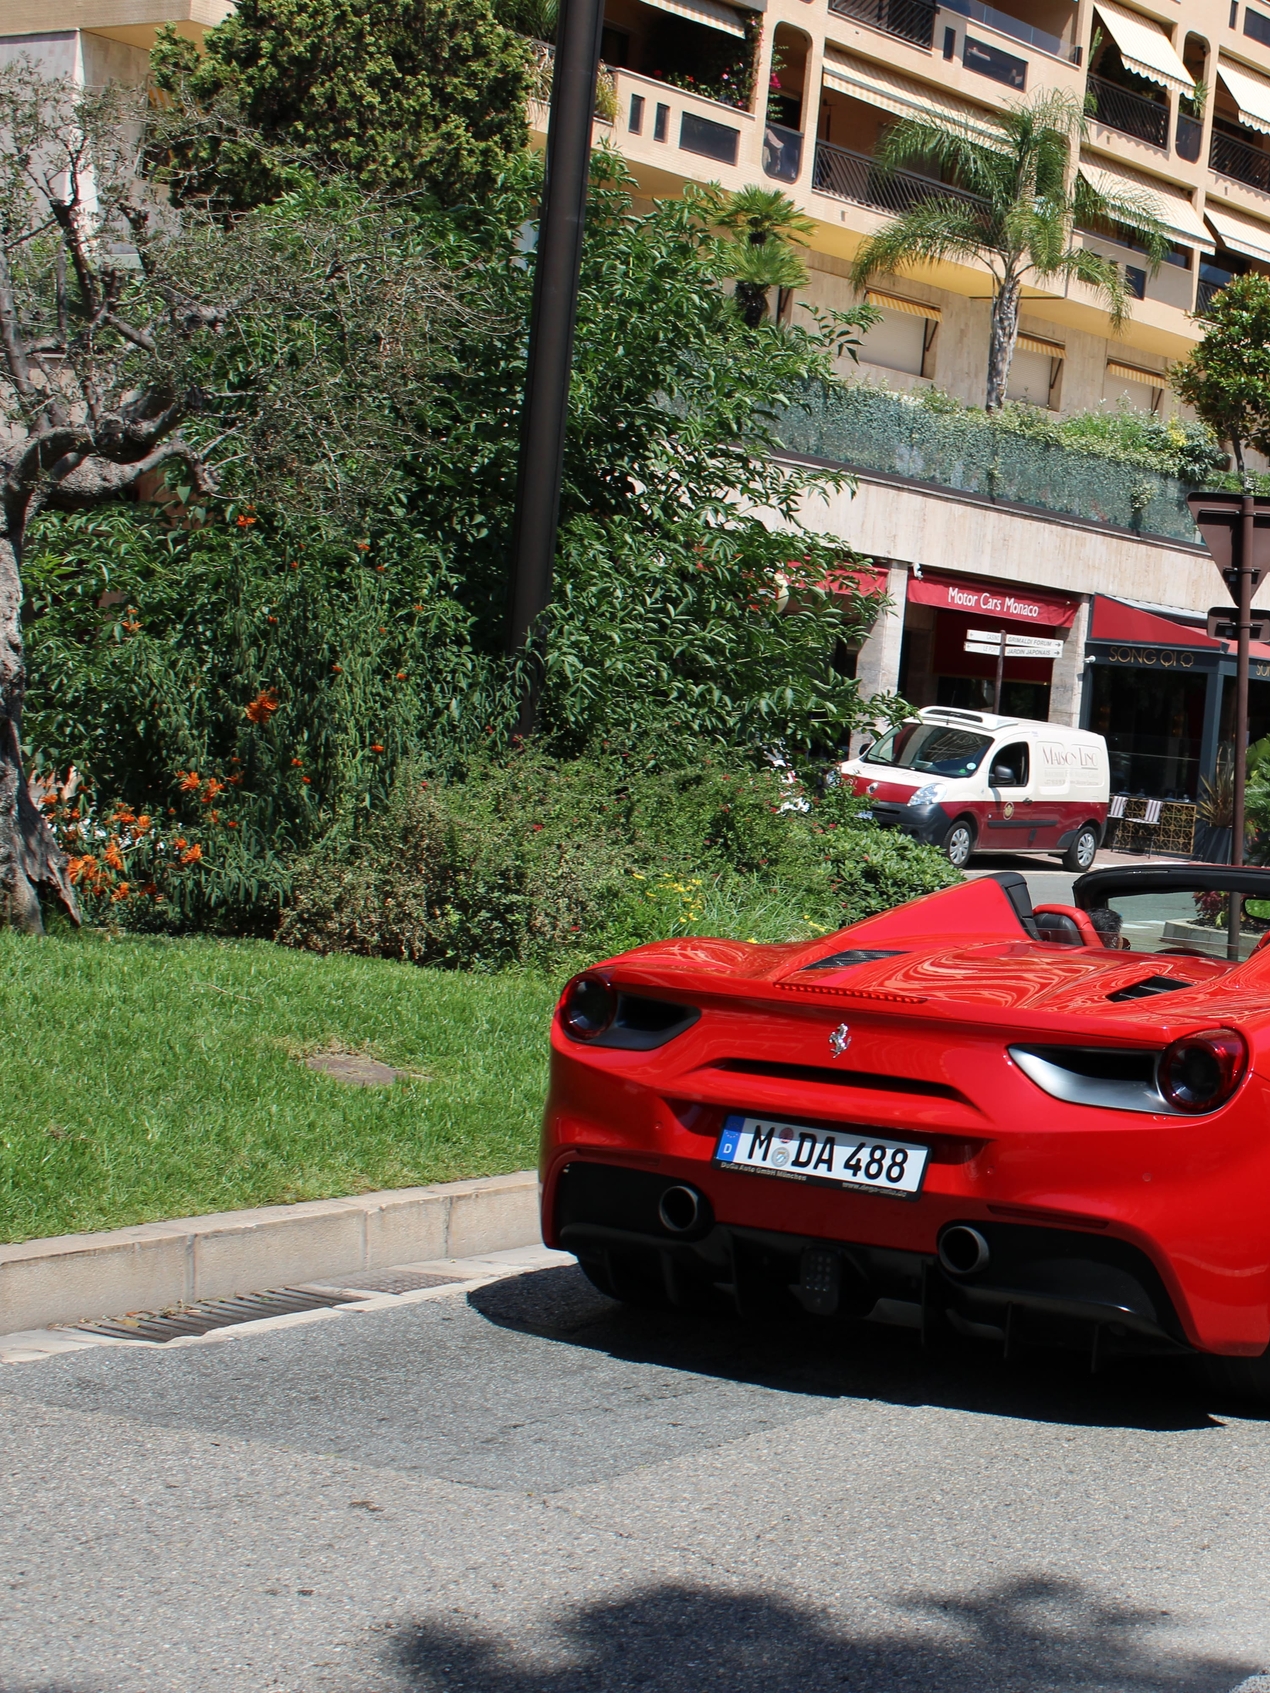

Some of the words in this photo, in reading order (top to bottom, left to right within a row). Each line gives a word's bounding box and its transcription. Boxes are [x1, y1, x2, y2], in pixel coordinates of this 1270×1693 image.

[948, 586, 978, 606] Motor
[980, 592, 1001, 611] Cars
[1004, 597, 1039, 617] Monaco
[1008, 636, 1032, 645] GRIMALDI
[1108, 646, 1156, 666] SONG
[1160, 650, 1177, 667] QI
[723, 1143, 733, 1154] D
[747, 1124, 776, 1162] M
[791, 1132, 836, 1172] DA
[843, 1142, 909, 1184] 488
[739, 1164, 756, 1172] Auto
[756, 1167, 776, 1176] GmbH
[776, 1170, 807, 1181] München
